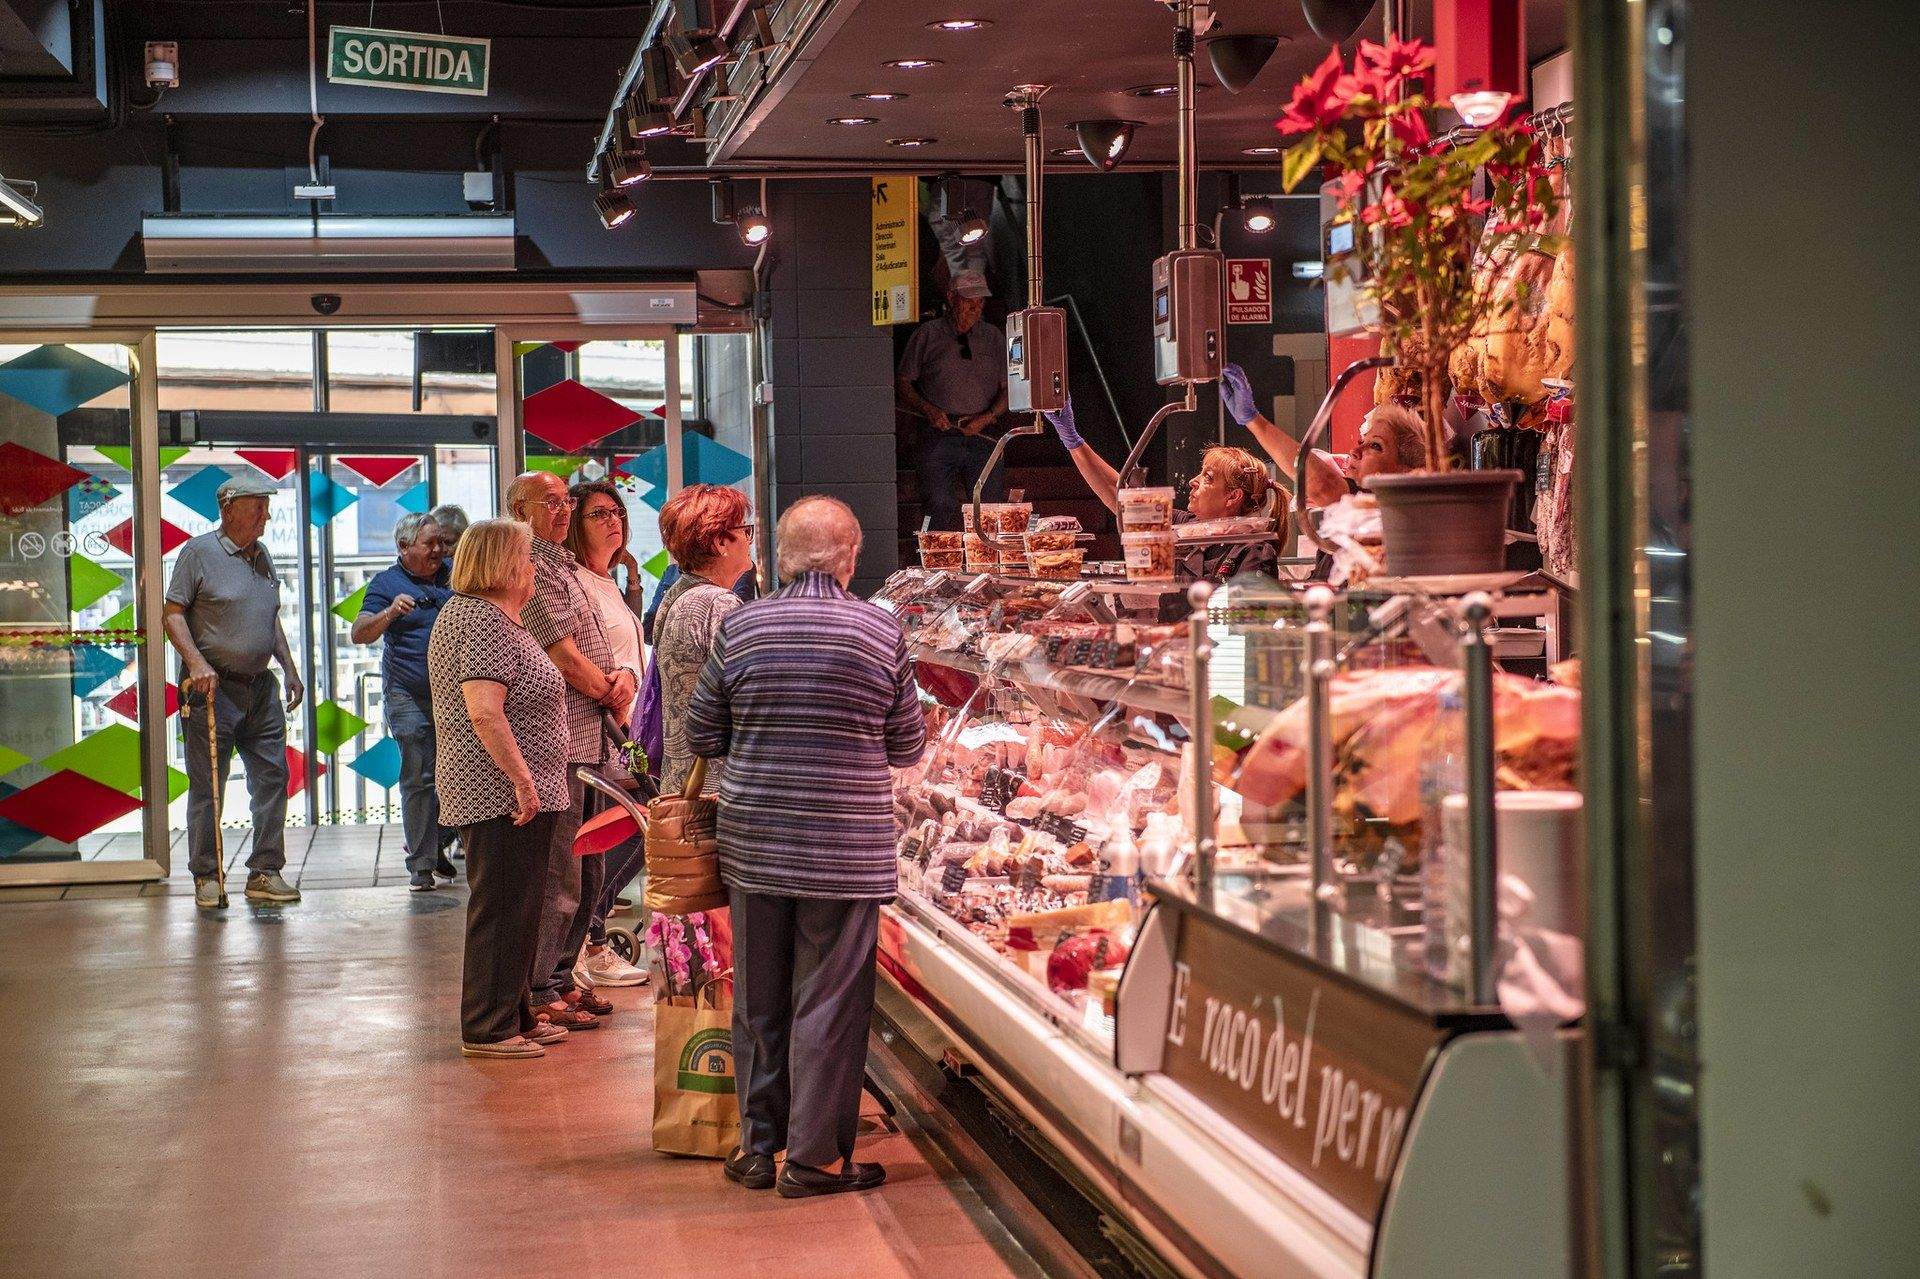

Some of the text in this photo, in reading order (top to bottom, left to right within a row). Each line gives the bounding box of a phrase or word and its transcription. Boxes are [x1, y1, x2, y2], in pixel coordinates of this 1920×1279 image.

[343, 39, 474, 83] SORTIDA
[1168, 962, 1191, 1046] E
[1200, 994, 1262, 1091] racó
[1262, 988, 1321, 1129] del
